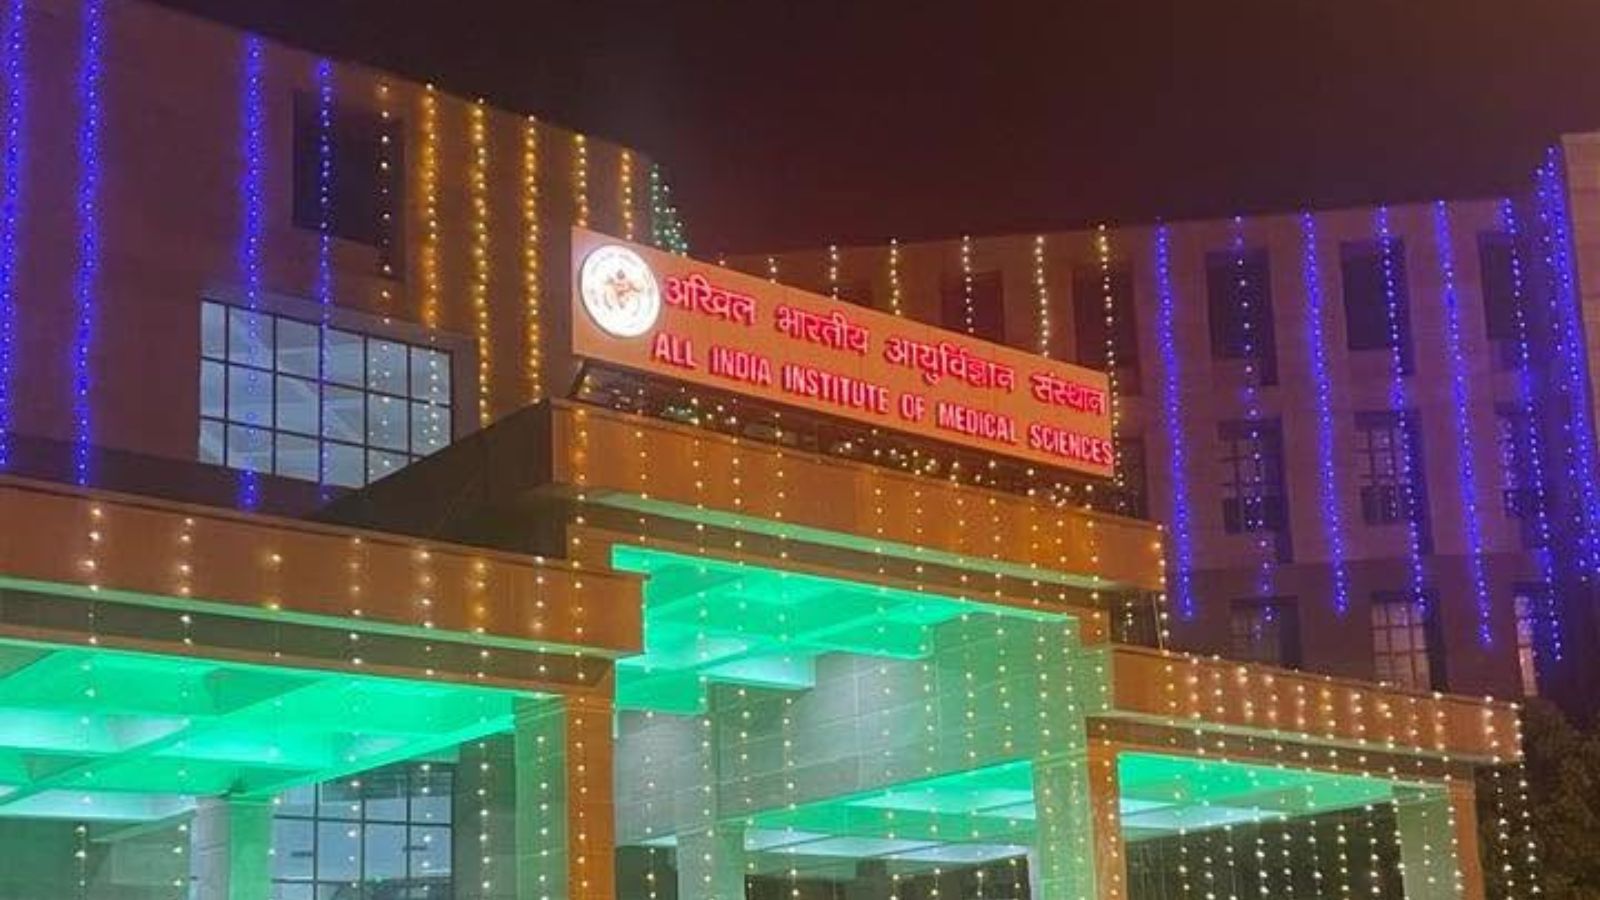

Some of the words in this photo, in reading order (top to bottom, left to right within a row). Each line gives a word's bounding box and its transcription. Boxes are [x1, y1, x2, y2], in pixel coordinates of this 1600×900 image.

[653, 333, 697, 368] ALL
[709, 347, 773, 385] INDIA
[783, 363, 890, 414] INSTITUTE
[901, 393, 926, 421] OF
[938, 402, 1018, 443] MEDICAL
[1029, 422, 1115, 466] SCIENCES
[664, 274, 756, 324] अखिल
[776, 305, 869, 355] भारतीय
[885, 336, 1015, 393] आयुर्विज्ञान
[1029, 371, 1107, 414] संस्थान
